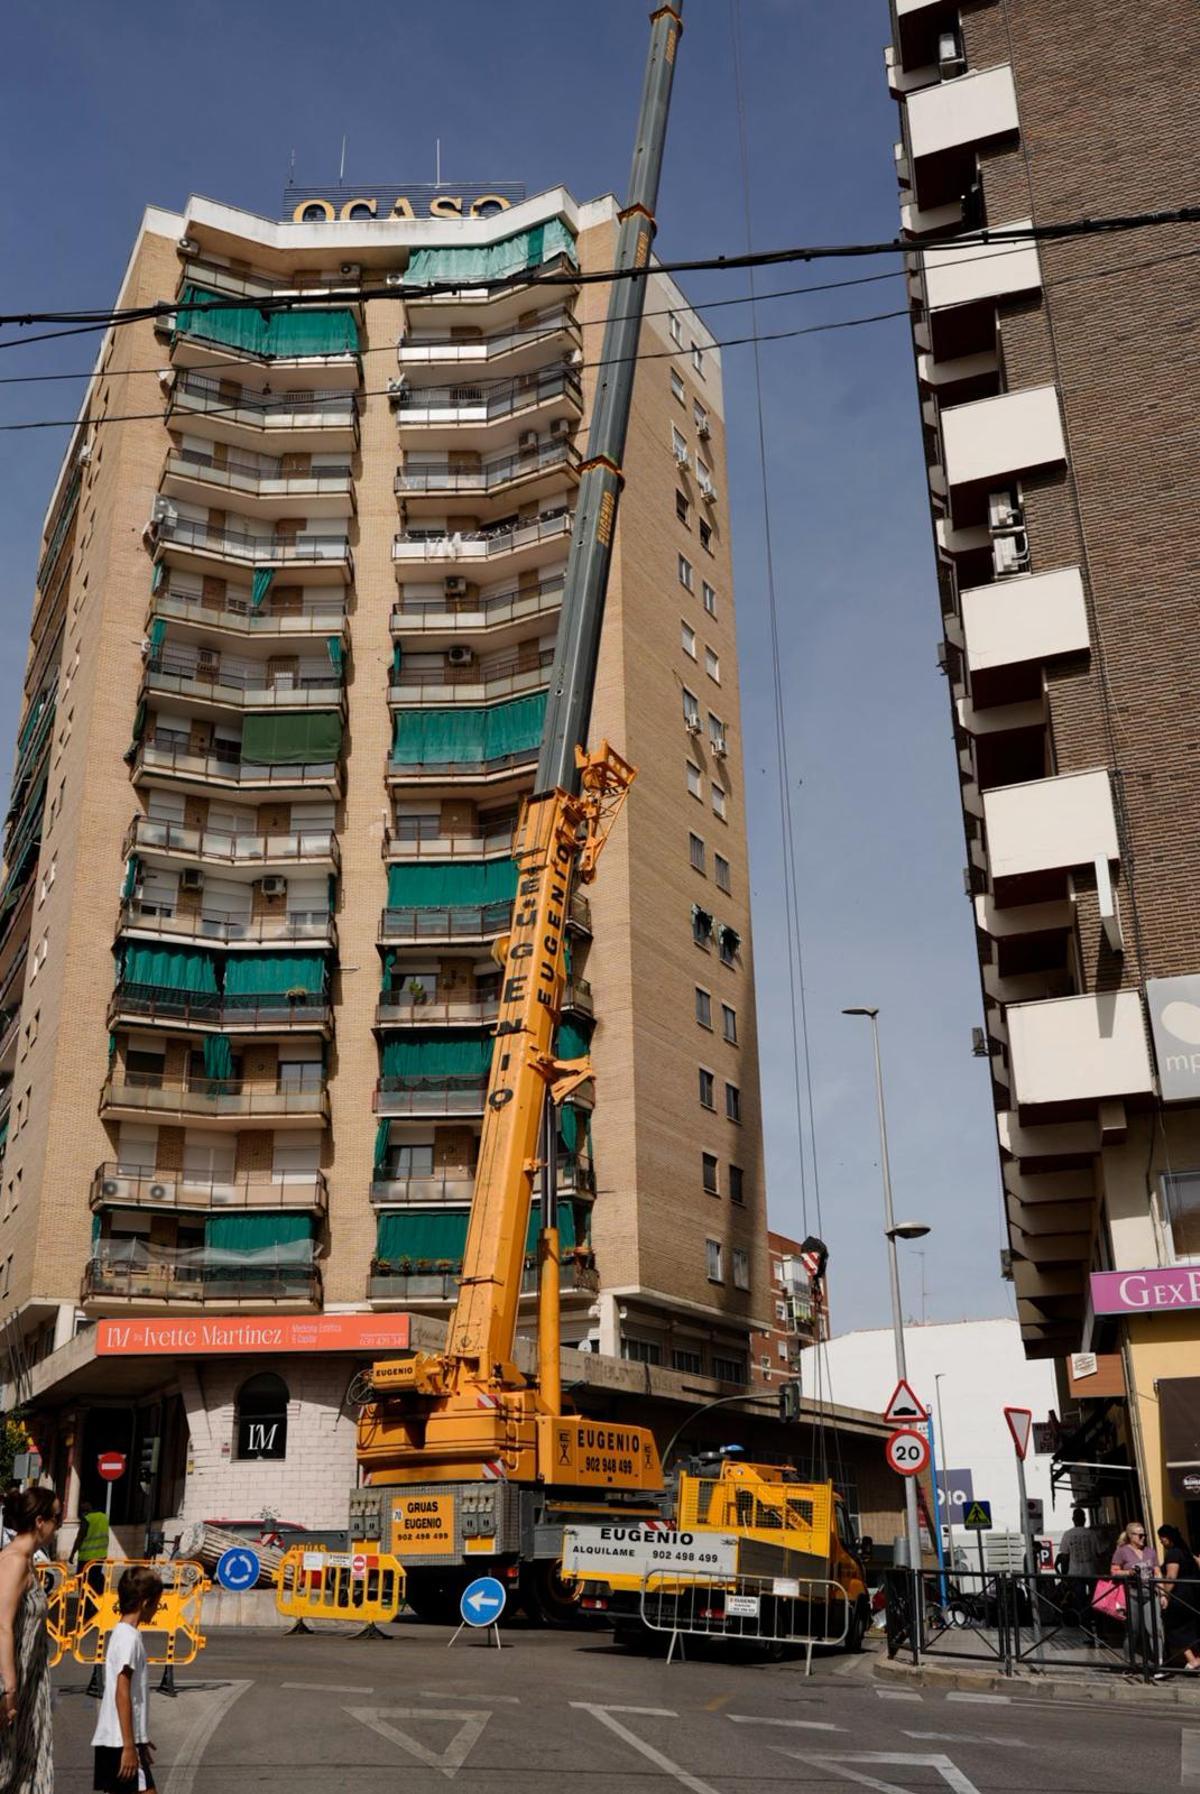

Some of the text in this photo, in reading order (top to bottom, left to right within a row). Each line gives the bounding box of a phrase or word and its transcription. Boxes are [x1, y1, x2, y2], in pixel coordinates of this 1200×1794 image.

[292, 194, 513, 223] OCASO
[537, 844, 570, 1006] EUGENIO
[488, 877, 540, 1109] EUGENIO
[144, 1327, 196, 1347] Ivette
[202, 1324, 282, 1346] Martínez
[376, 1366, 413, 1377] EUGENIO
[578, 1429, 640, 1453] EUGENIO
[896, 1446, 920, 1461] 20
[586, 1456, 632, 1475] 902 948 499
[407, 1501, 438, 1513] GRUAS
[404, 1517, 442, 1529] EUGENIO
[397, 1533, 413, 1541] 902
[600, 1528, 694, 1546] EUGENIO
[572, 1545, 718, 1564] ALQUILAME 902 498 499
